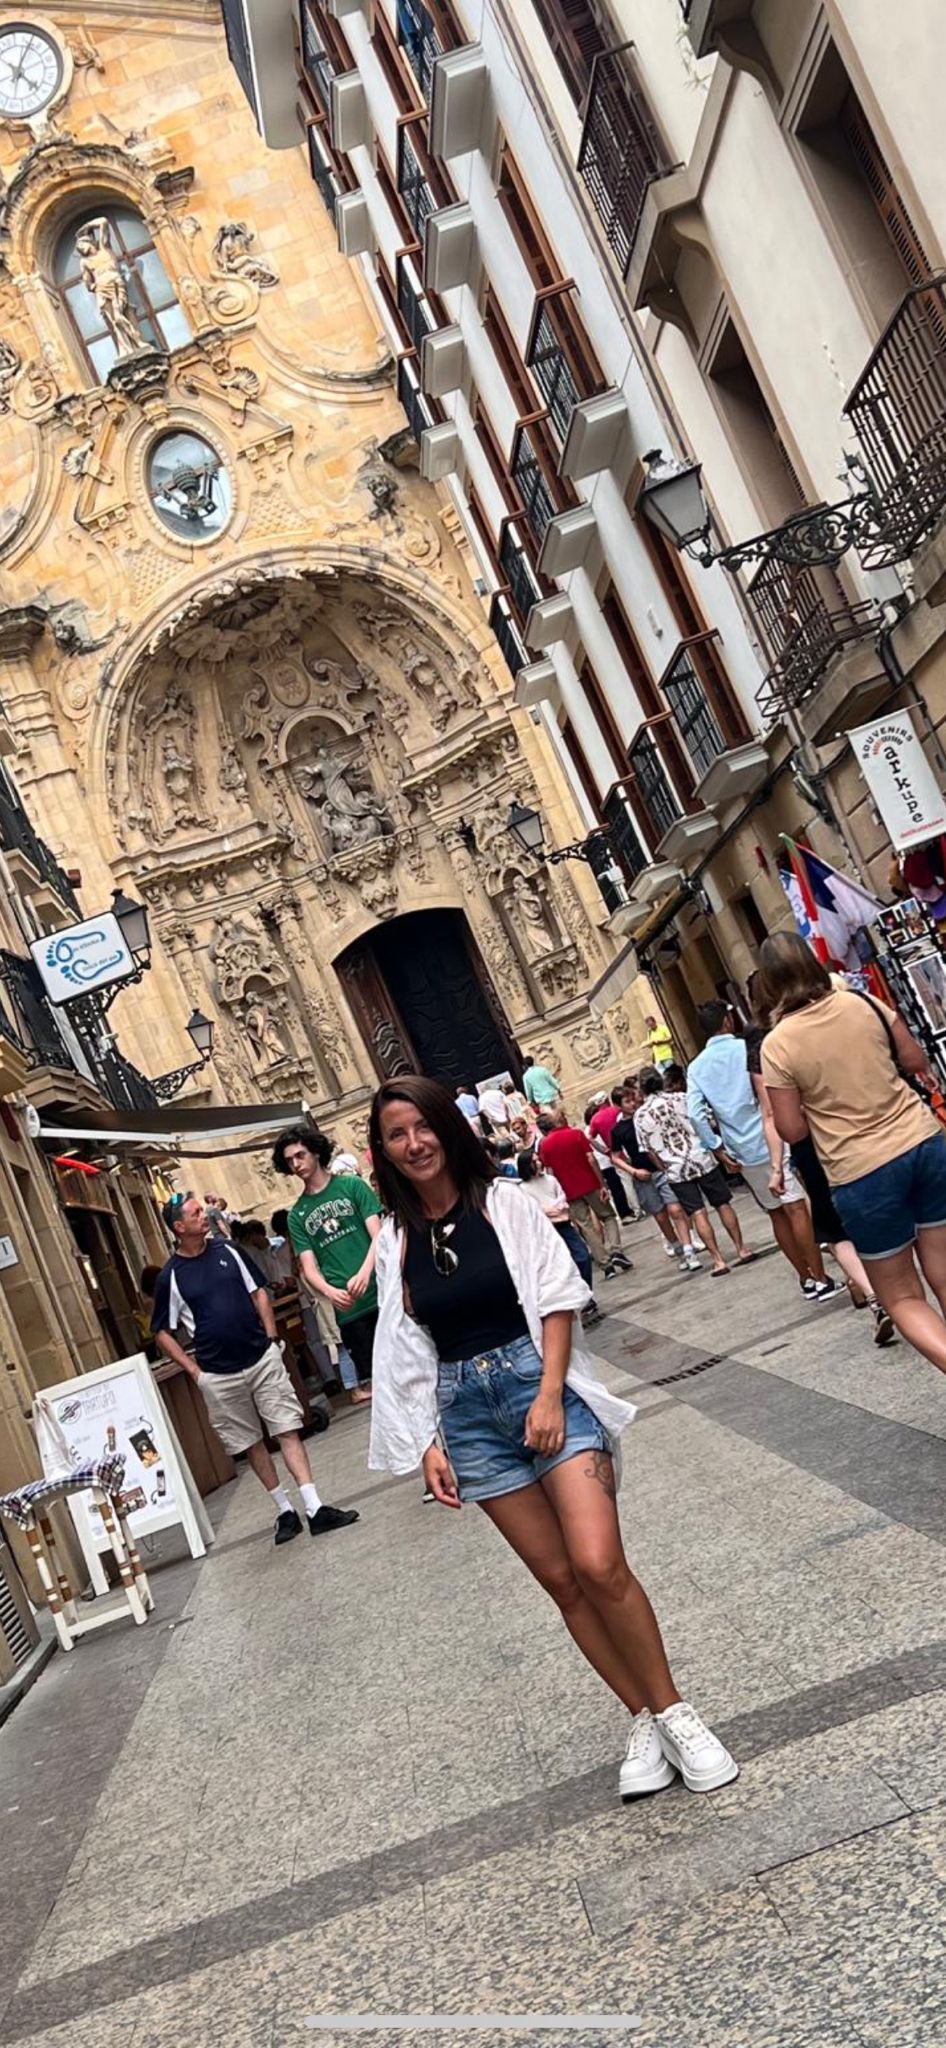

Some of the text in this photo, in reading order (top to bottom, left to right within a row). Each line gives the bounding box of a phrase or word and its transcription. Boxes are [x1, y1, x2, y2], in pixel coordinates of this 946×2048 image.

[862, 726, 914, 759] SOUVENIRS
[884, 746, 924, 823] arkupe
[305, 1198, 355, 1237] CELTICS
